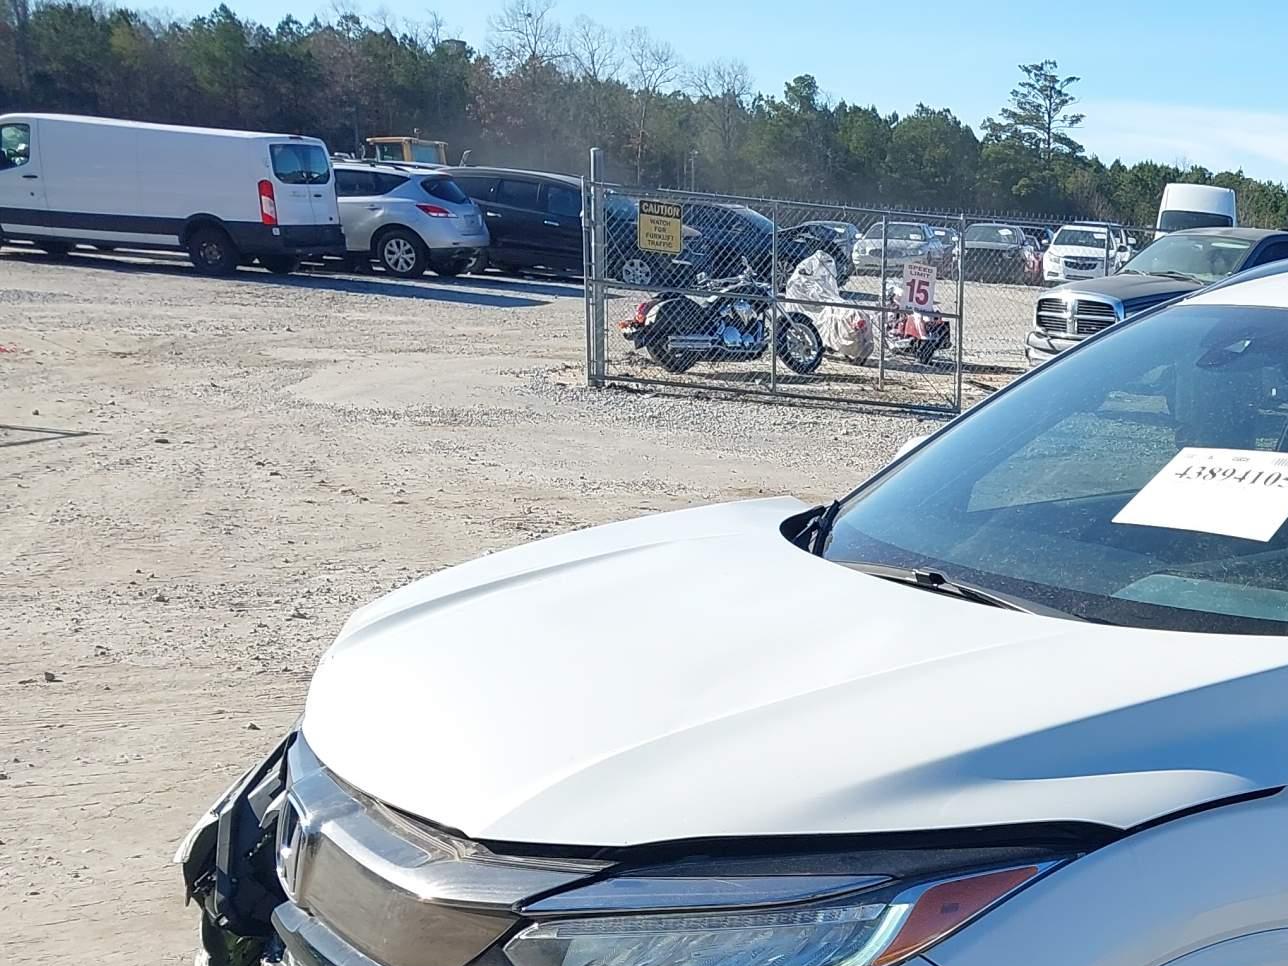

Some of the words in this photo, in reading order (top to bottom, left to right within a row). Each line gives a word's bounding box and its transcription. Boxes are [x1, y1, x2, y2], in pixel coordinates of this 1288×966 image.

[641, 202, 681, 217] CAUTION
[649, 219, 671, 227] WATCH
[645, 231, 674, 241] FORKLIFT
[647, 239, 673, 249] TRAFFIC
[908, 264, 933, 274] SPEED
[910, 271, 930, 279] LIMIT
[906, 279, 930, 306] 15
